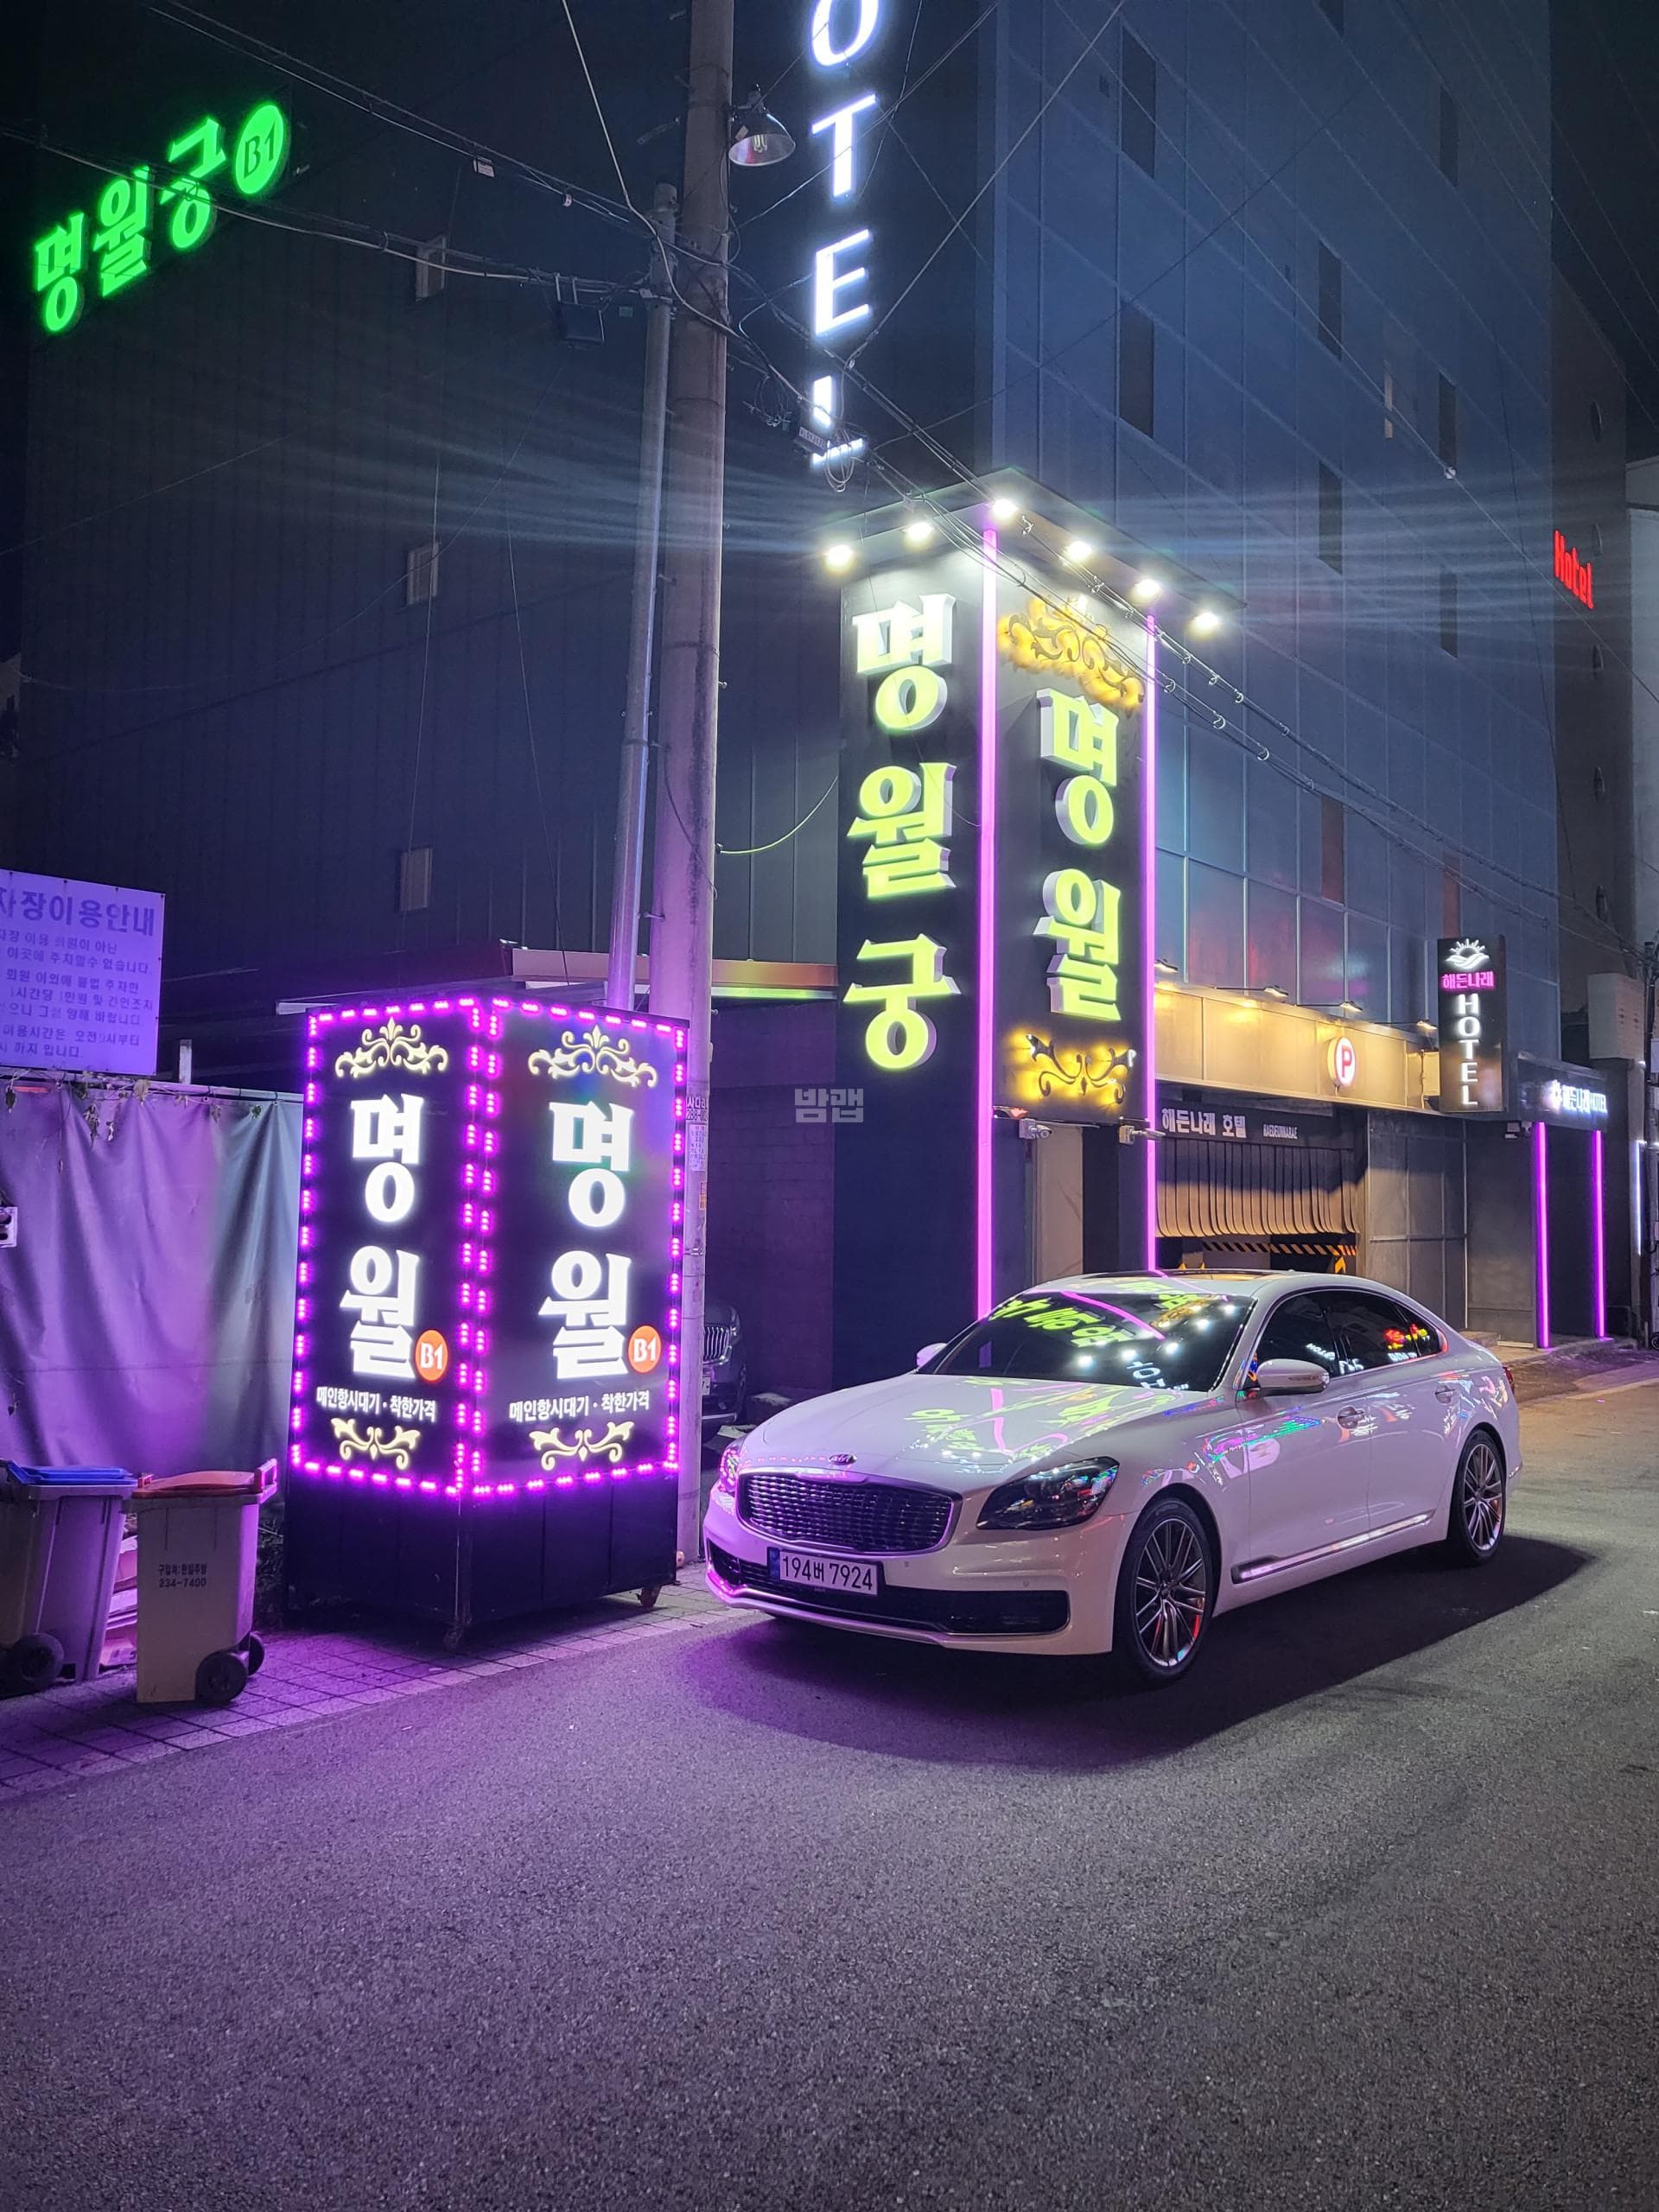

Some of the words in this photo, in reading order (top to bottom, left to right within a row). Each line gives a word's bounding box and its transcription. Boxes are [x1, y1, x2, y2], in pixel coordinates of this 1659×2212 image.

[34, 118, 226, 332] 명월궁
[244, 122, 276, 179] B1
[843, 594, 961, 1070] 명월궁
[1033, 688, 1122, 1022] 명월
[24, 932, 49, 947] 이용
[95, 941, 118, 955] 아닌
[6, 968, 30, 982] 회원
[1442, 971, 1494, 989] 해든나래
[1341, 1045, 1352, 1078] P
[1458, 993, 1481, 1106] HOTEL
[1161, 1108, 1216, 1135] 해든나래
[1223, 1114, 1247, 1138] 호텔
[340, 1093, 424, 1379] 명월
[419, 1342, 443, 1370] B1
[537, 1100, 634, 1379] 명월
[633, 1336, 658, 1363] B1
[390, 1395, 435, 1422] 착한가격
[509, 1395, 589, 1422] 메인항시대기
[601, 1390, 650, 1414] 착한가격
[783, 1555, 824, 1582] 194버
[829, 1563, 873, 1591] 7924
